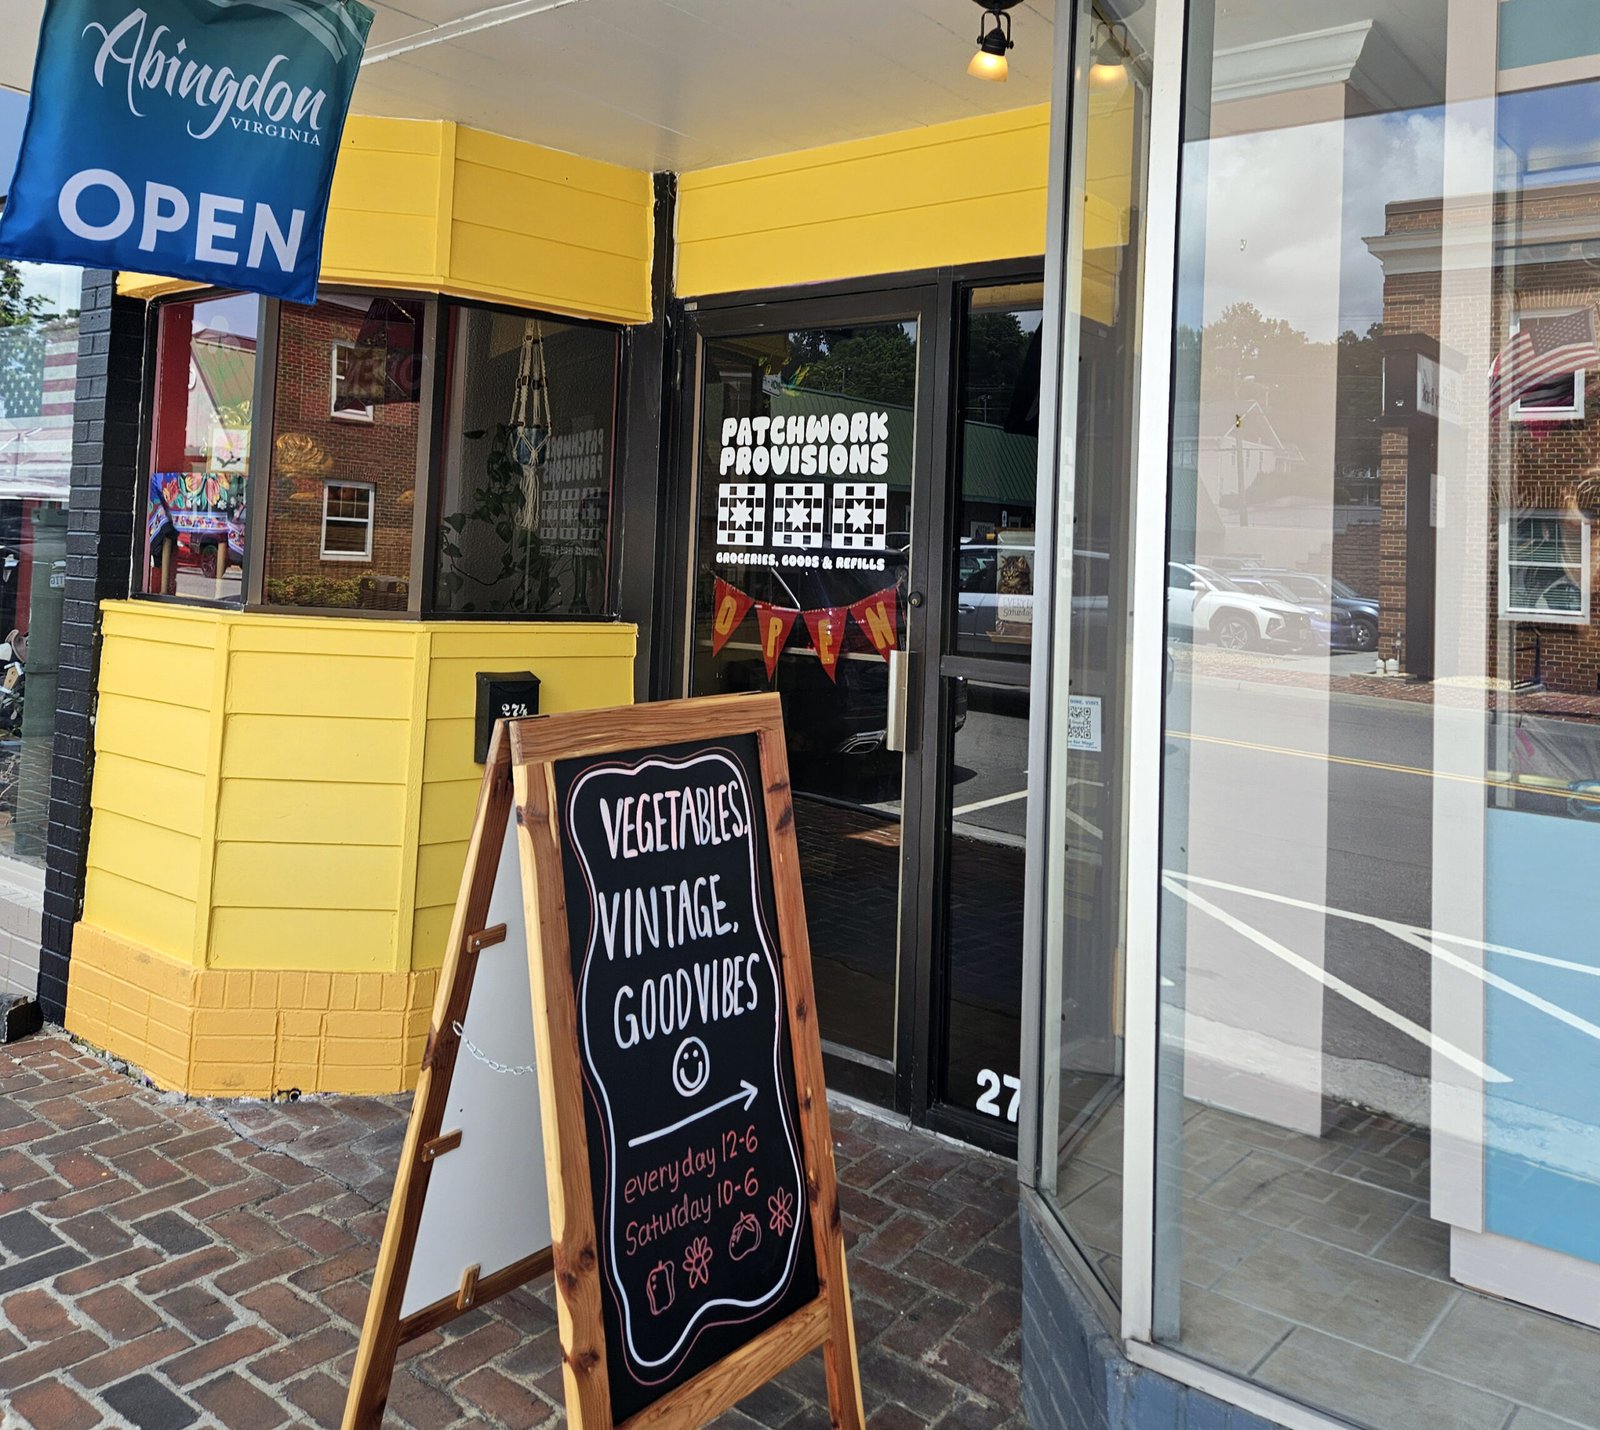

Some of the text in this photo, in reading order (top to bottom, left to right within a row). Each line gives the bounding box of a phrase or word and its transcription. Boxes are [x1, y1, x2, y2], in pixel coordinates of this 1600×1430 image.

[82, 8, 327, 140] Abingdon
[230, 116, 321, 146] VIRGINIA
[58, 168, 306, 273] OPEN
[719, 442, 889, 476] PROVISIONS
[721, 411, 889, 446] PATCHWORK
[716, 552, 885, 572] GROCERIES, GOODS & REFILLS
[714, 595, 895, 665] OPEN
[501, 703, 528, 717] 274
[600, 780, 748, 860] VEGETABLES,
[624, 1124, 758, 1203] everyday 12-6
[625, 1167, 759, 1256] Saturday 10-6
